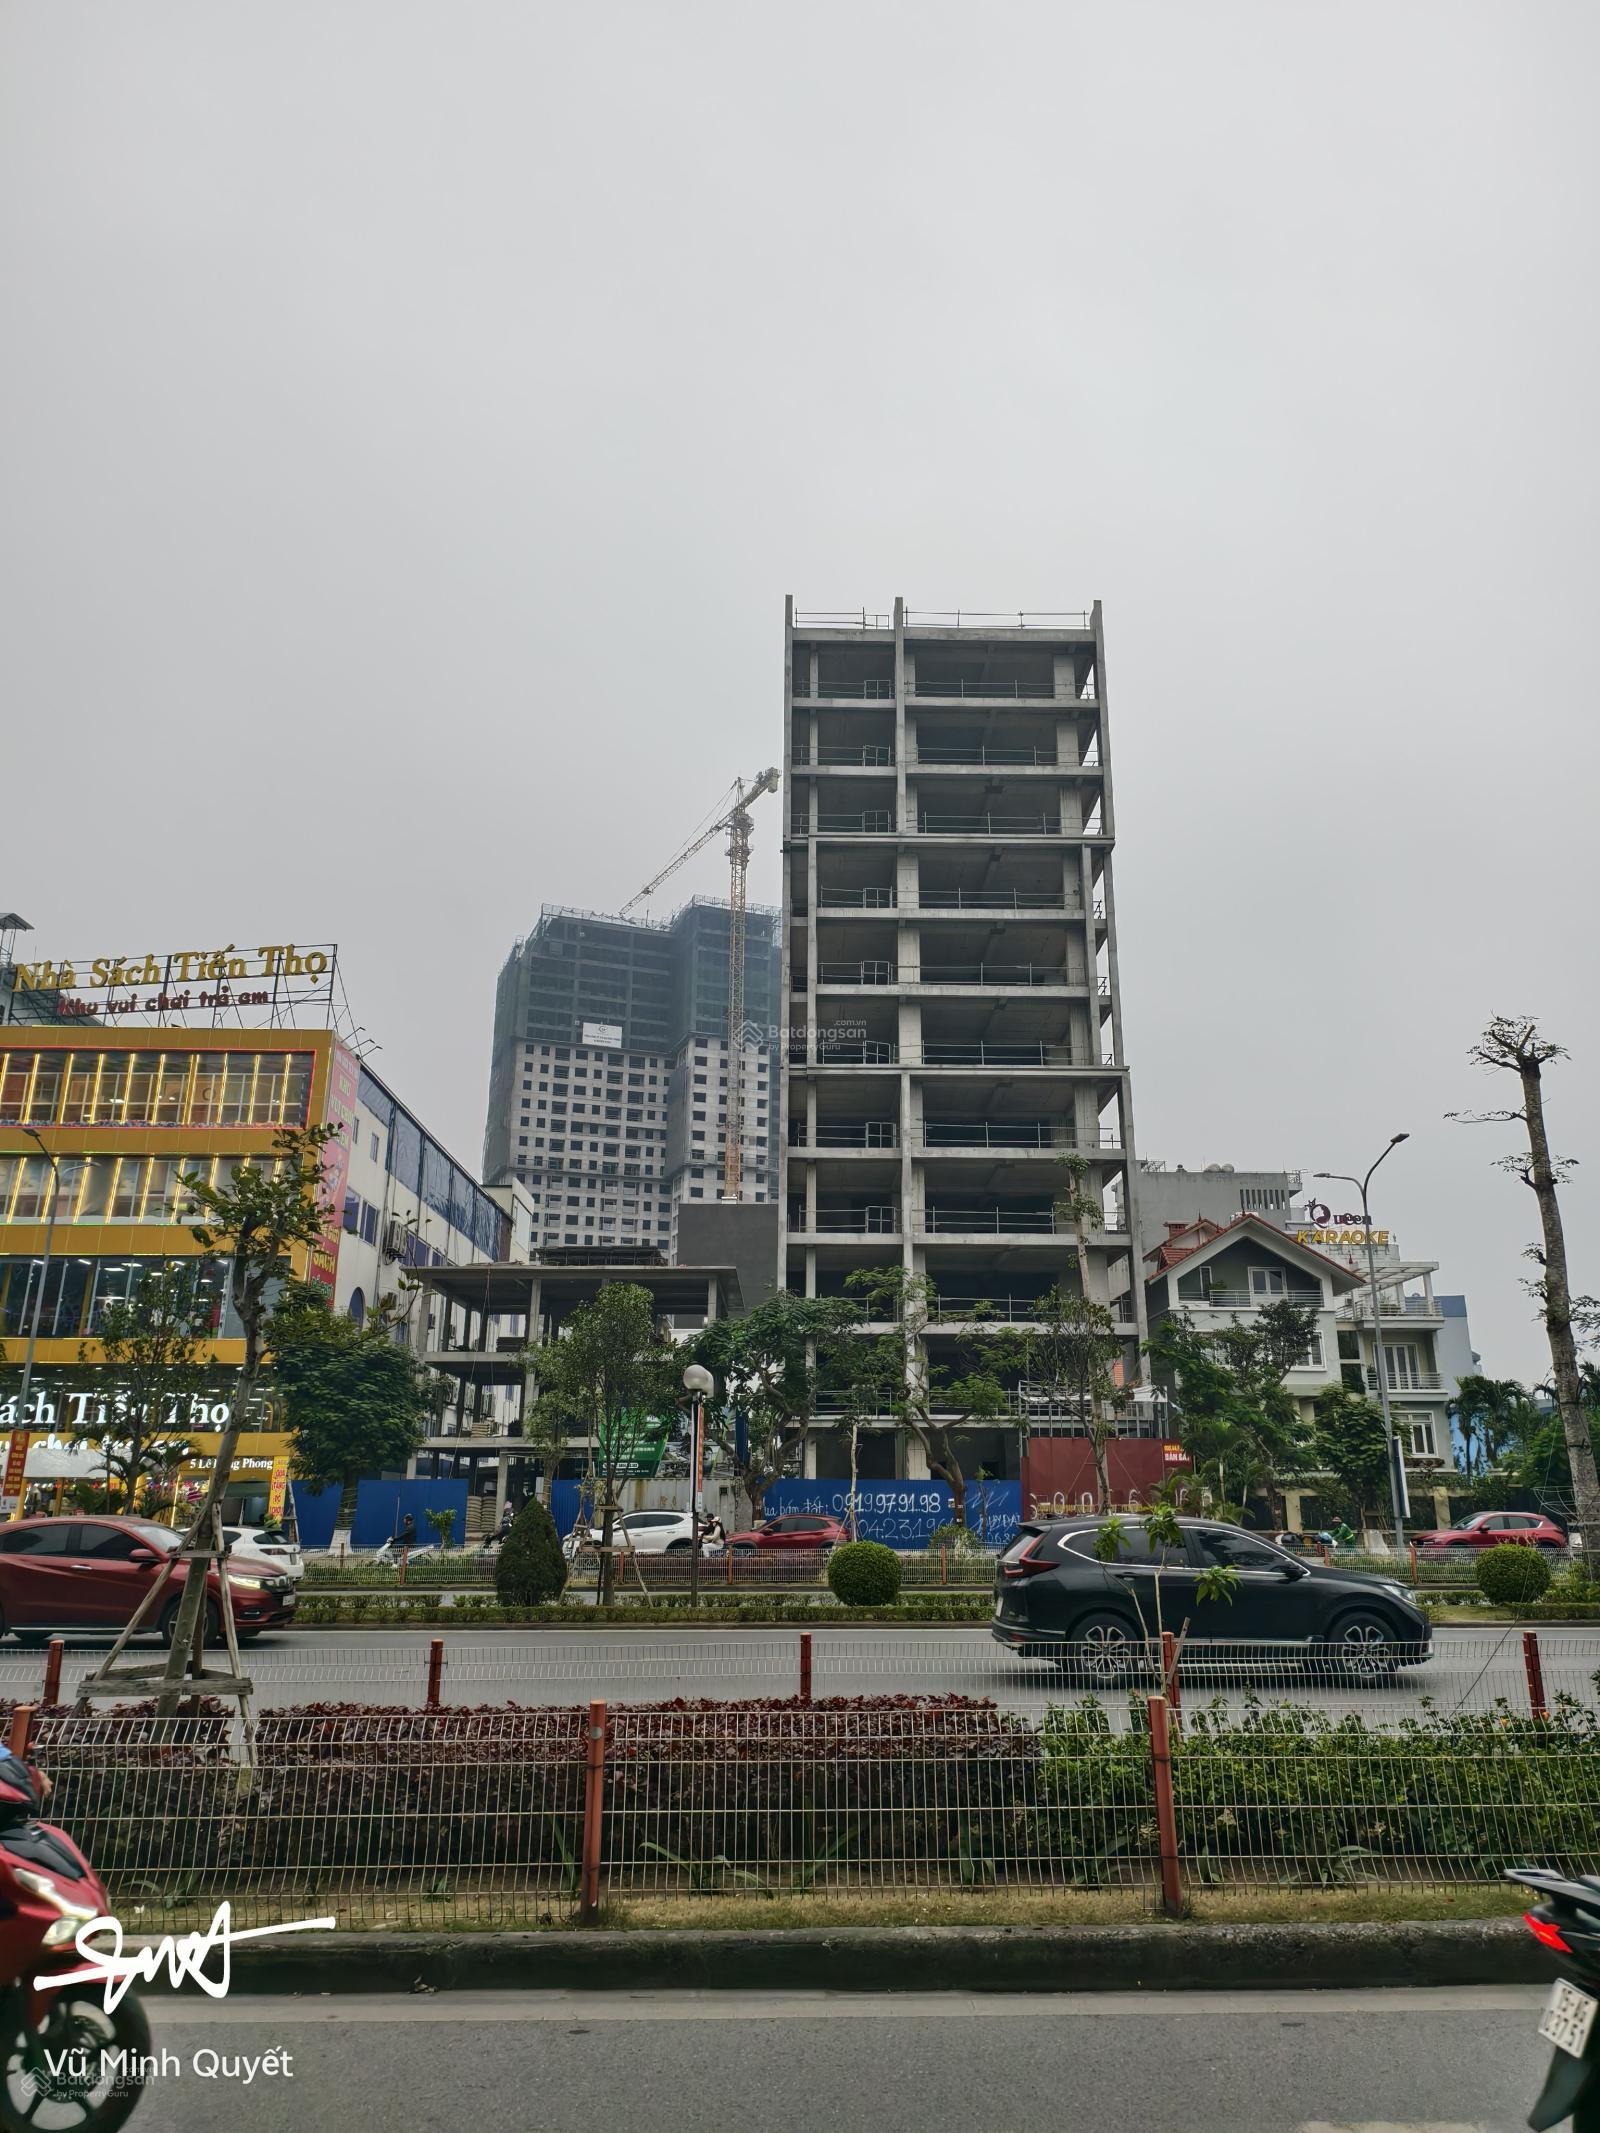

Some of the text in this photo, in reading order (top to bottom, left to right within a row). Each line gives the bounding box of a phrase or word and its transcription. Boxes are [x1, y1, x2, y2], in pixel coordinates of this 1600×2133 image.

[13, 944, 327, 992] Nhà Sách Tiến Thọ
[108, 993, 137, 1013] vui
[145, 989, 190, 1011] chơi
[238, 991, 268, 1005] em
[1297, 1229, 1389, 1245] KARAOKE
[0, 1391, 56, 1425] ách
[190, 1458, 196, 1469] 5
[198, 1458, 212, 1469] Lê
[242, 1457, 273, 1471] Phong
